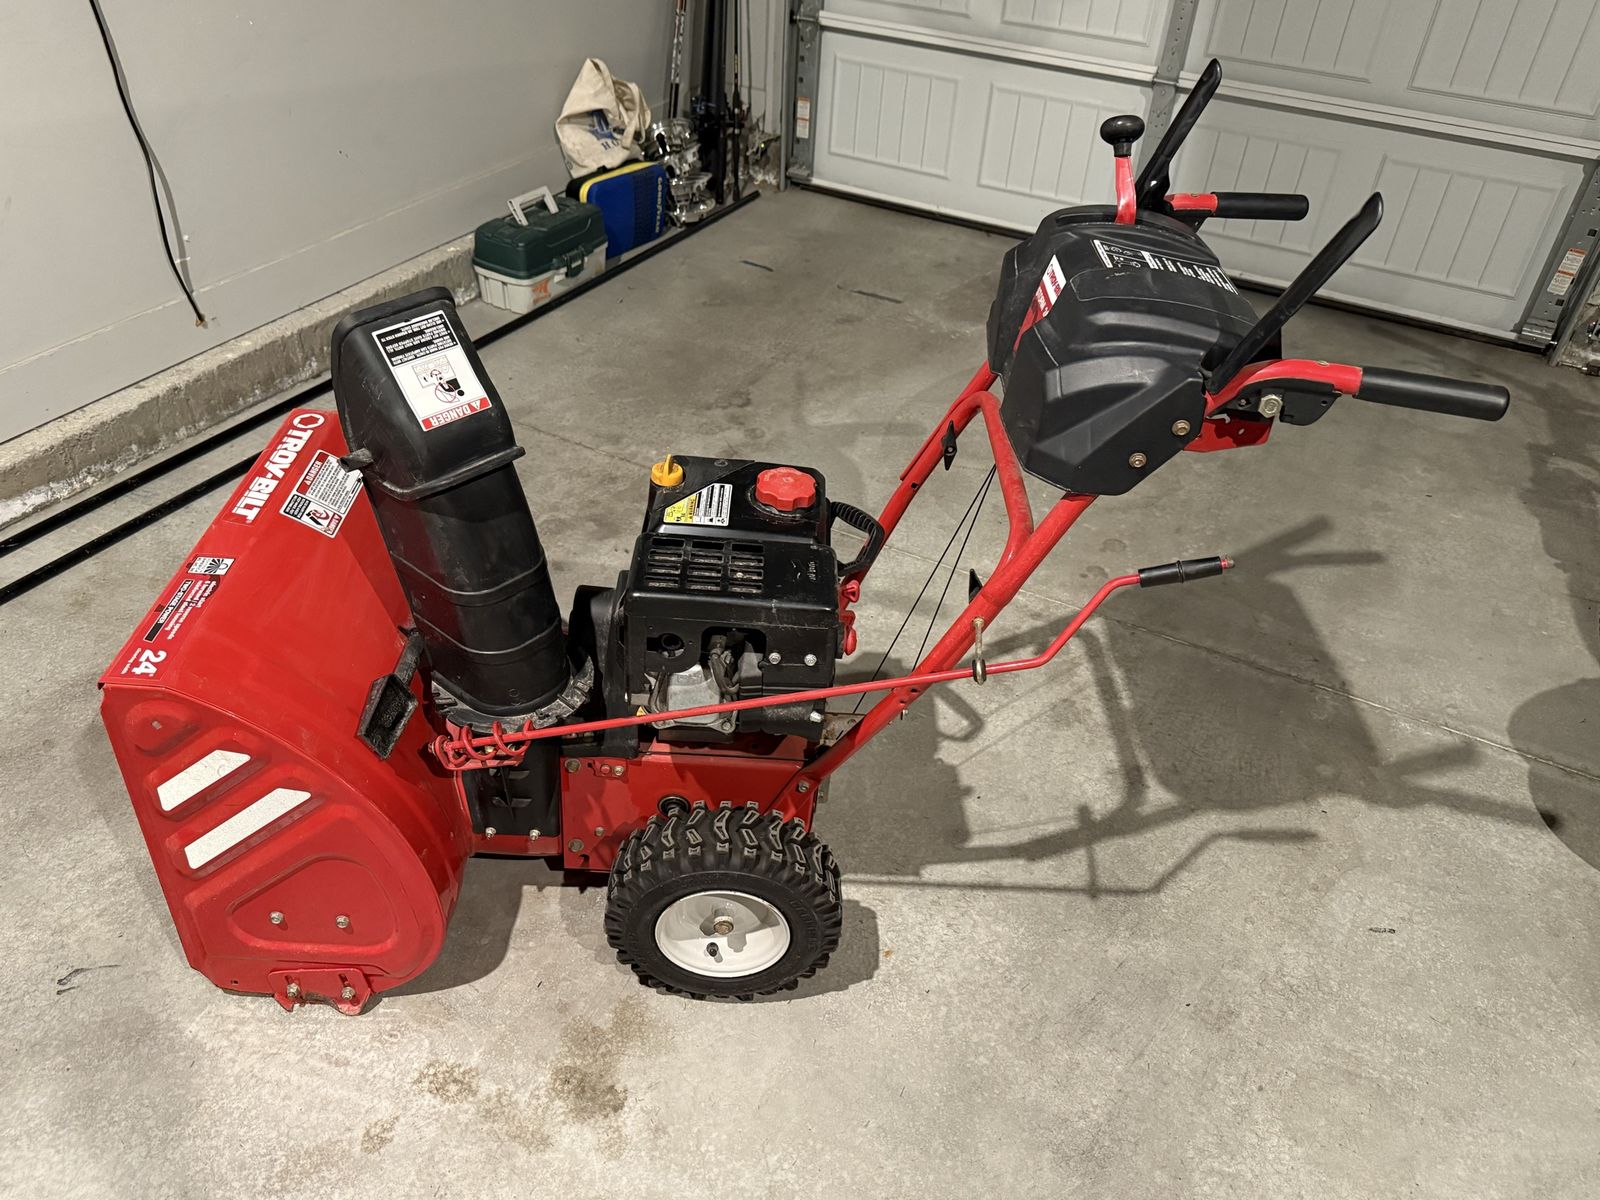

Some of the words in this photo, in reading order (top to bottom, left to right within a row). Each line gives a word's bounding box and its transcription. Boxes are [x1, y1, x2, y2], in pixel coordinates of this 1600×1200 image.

[431, 402, 473, 427] DANGER
[232, 428, 314, 523] TROY-BILT
[307, 460, 323, 481] DANGER
